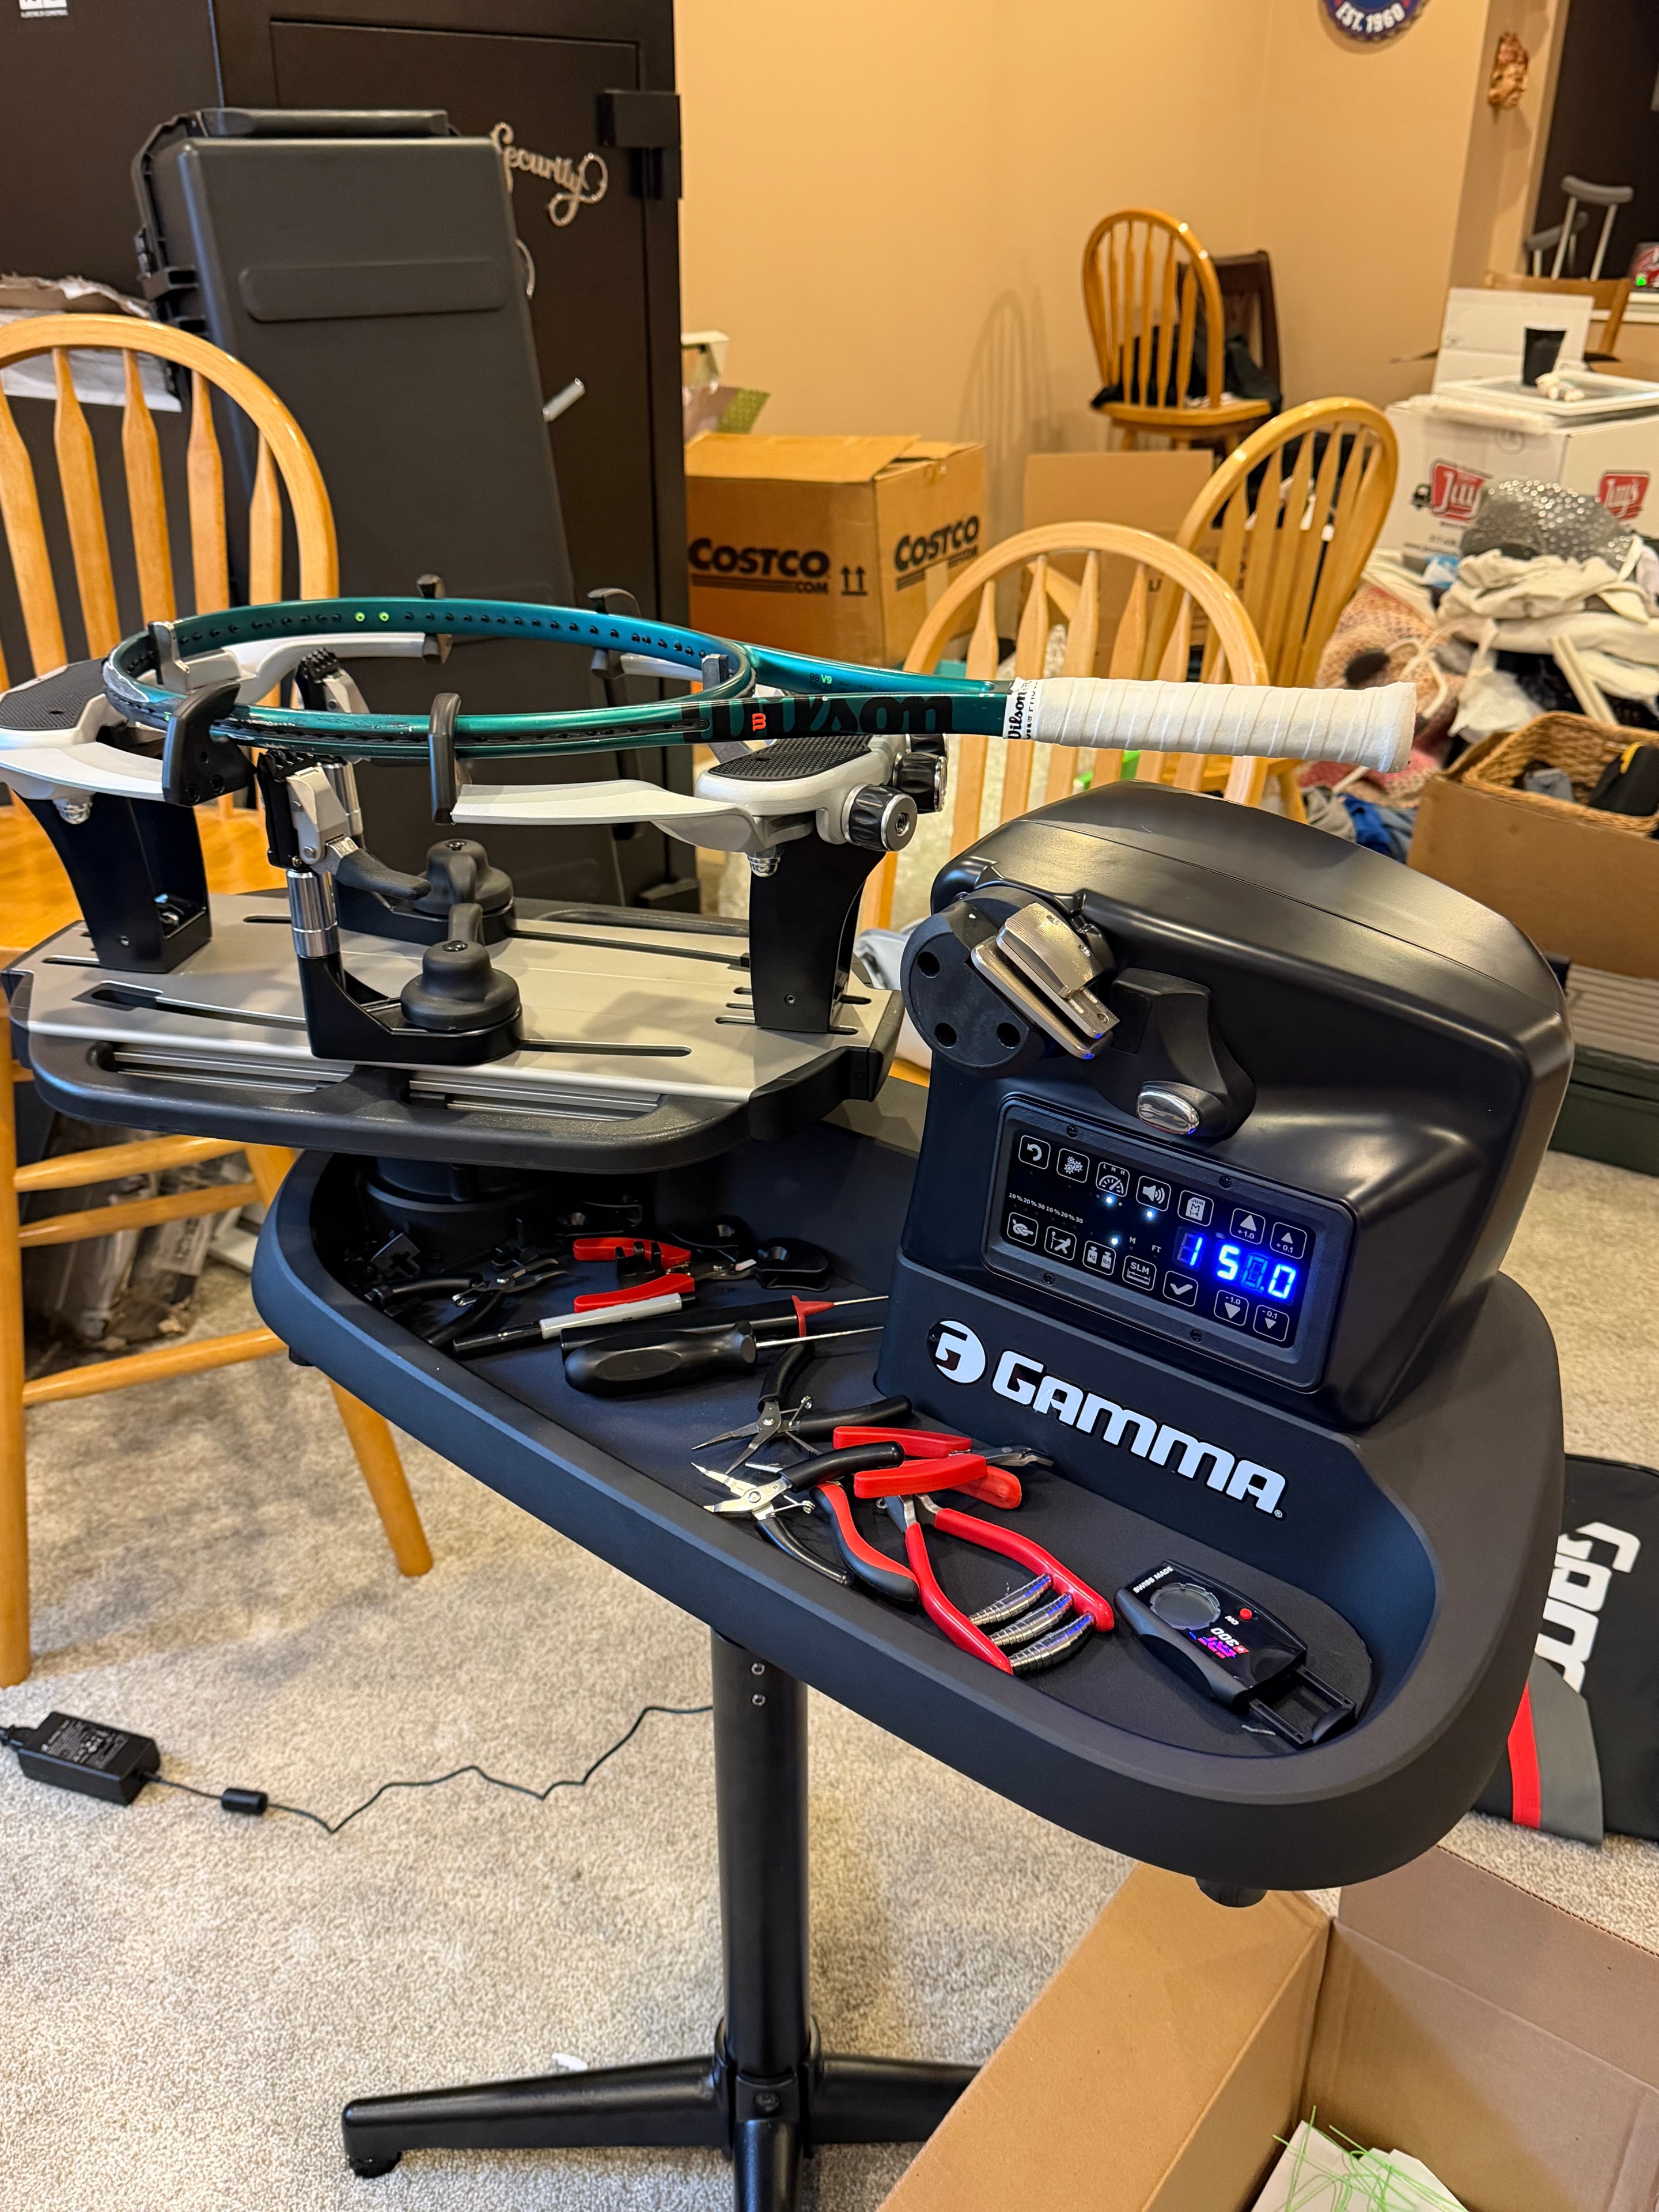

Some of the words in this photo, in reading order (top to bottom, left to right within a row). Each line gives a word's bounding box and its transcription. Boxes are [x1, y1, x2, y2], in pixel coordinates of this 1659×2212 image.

[1366, 3, 1405, 33] 1960
[689, 538, 830, 576] COSTCO
[895, 516, 979, 573] COSTCO
[809, 673, 819, 681] 98
[821, 675, 832, 684] V9
[1152, 1245, 1161, 1253] FT
[1130, 1262, 1150, 1275] SLM
[993, 1350, 1286, 1514] GAMMA
[1133, 1577, 1155, 1594] SWISS
[1154, 1566, 1174, 1581] MADE
[1210, 1628, 1240, 1647] 300
